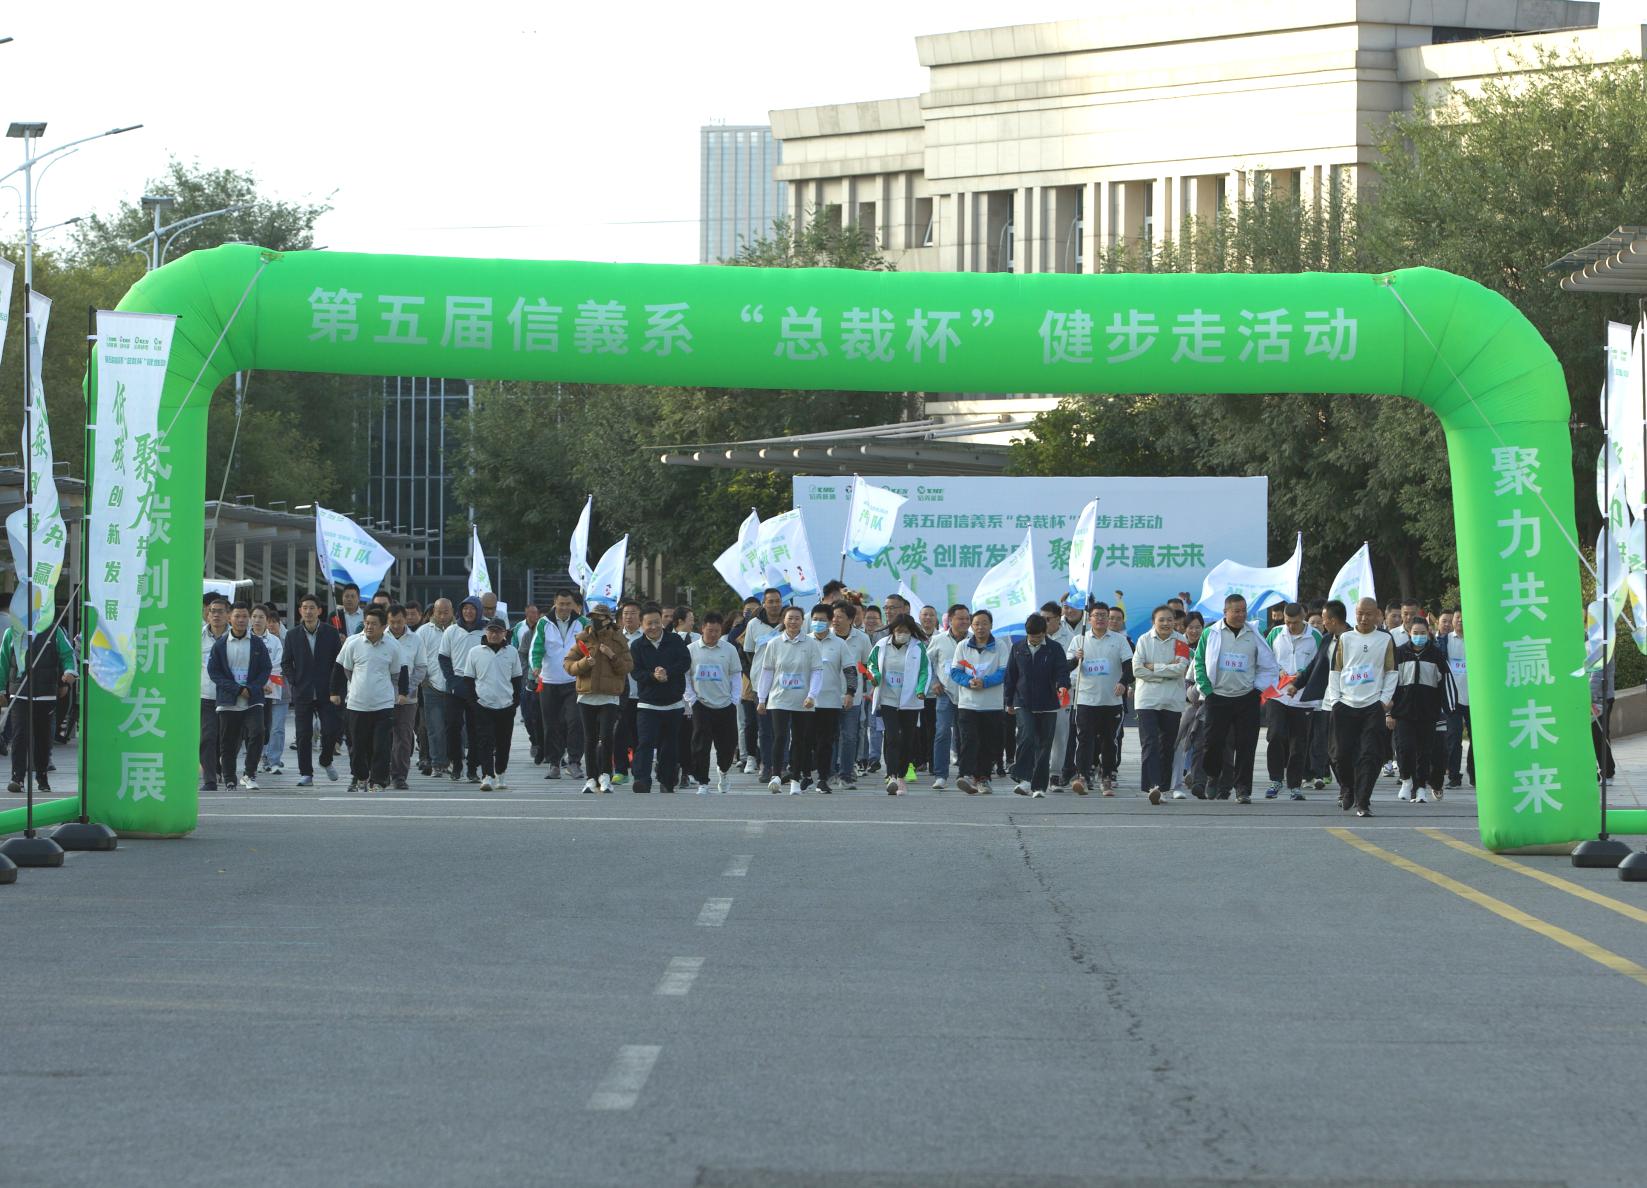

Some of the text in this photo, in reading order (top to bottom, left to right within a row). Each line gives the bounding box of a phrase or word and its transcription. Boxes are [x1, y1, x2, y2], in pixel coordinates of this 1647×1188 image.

[903, 513, 1163, 529] 第五届信義系“总裁杯”步走活动
[1491, 445, 1564, 814] 聚力共赢未来
